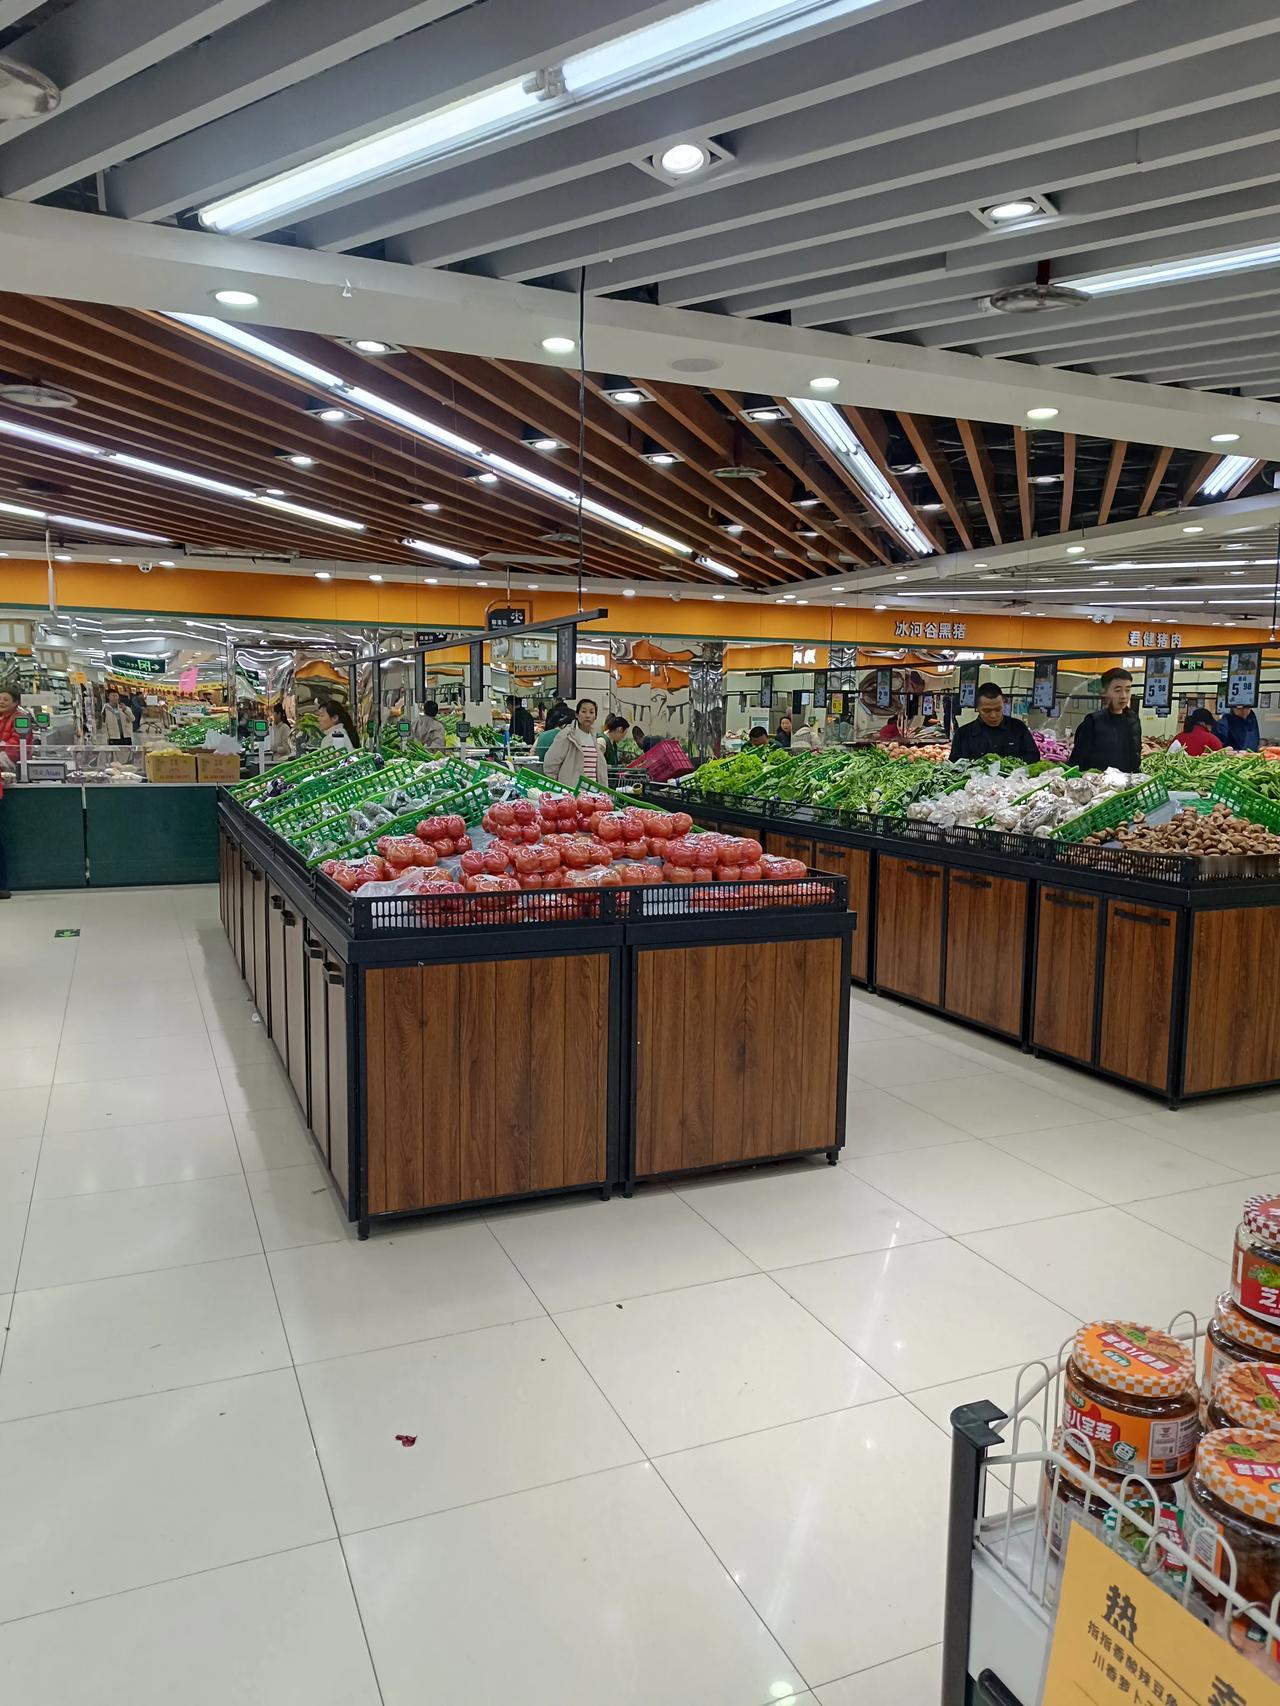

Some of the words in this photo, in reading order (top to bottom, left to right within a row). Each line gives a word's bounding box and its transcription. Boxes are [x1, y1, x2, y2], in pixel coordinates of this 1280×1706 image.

[896, 620, 966, 639] 冰河谷黑猪
[1129, 630, 1182, 648] 君健猪肉
[1101, 1584, 1138, 1644] 热
